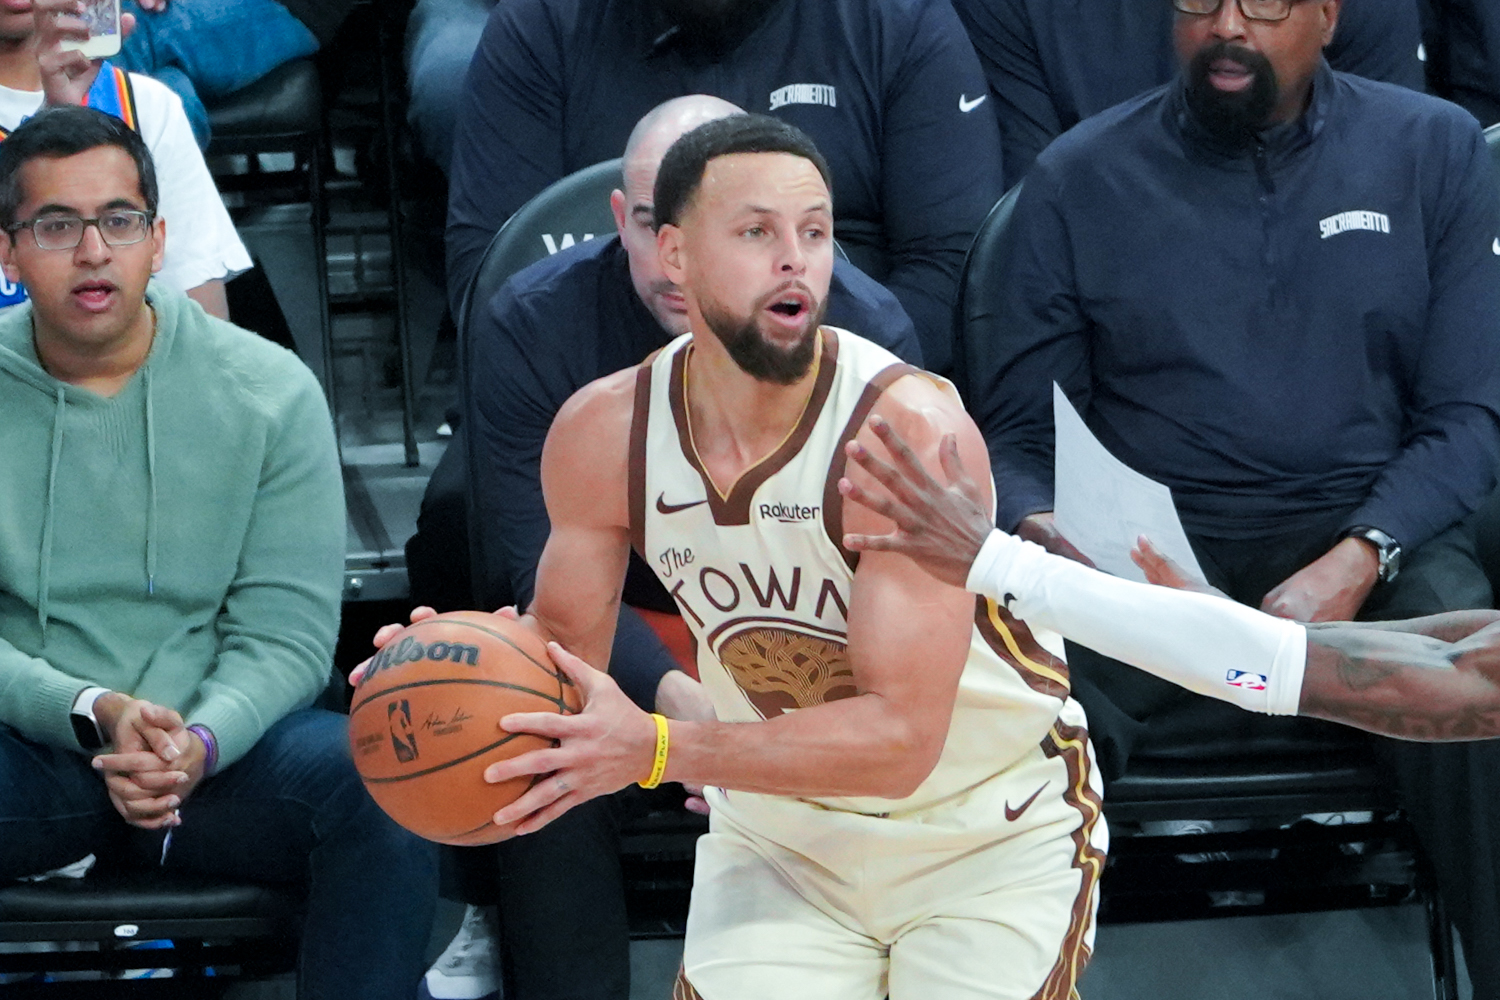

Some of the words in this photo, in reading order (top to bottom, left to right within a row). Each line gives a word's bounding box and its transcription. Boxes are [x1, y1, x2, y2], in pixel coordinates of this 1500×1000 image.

[768, 83, 837, 111] SACRAMENTO
[1319, 209, 1391, 239] SACRAMENTO
[659, 548, 695, 588] The
